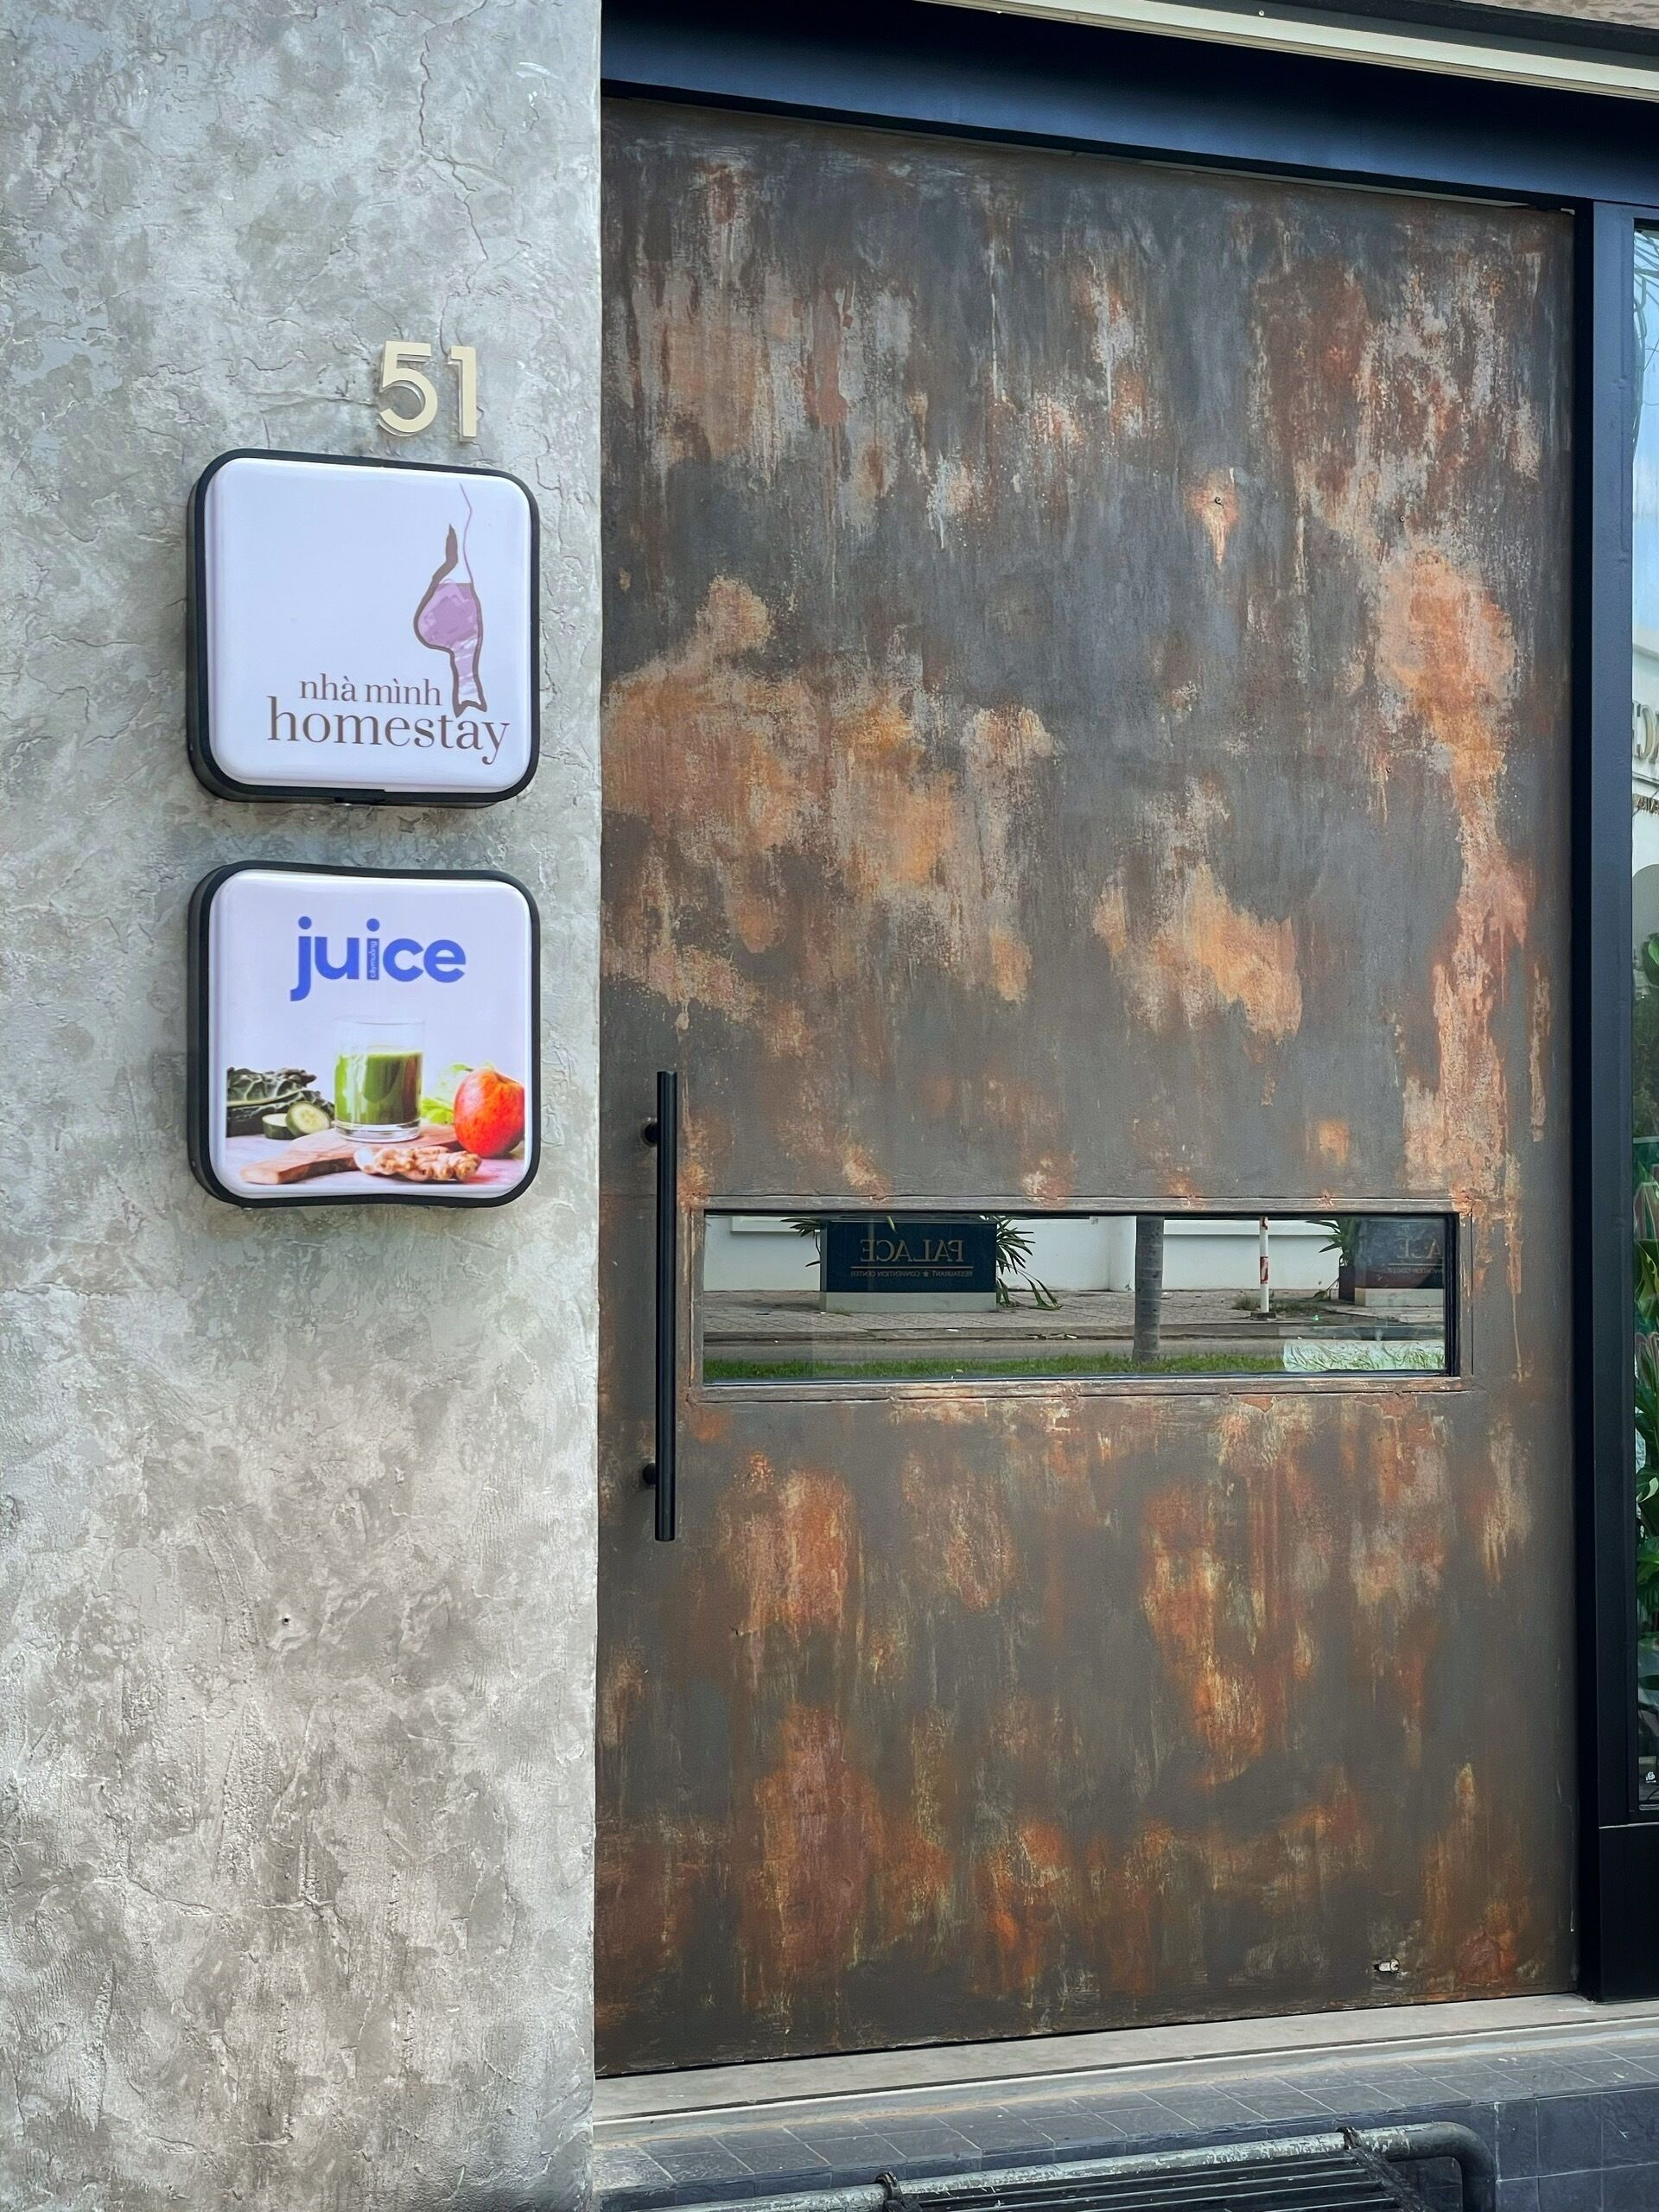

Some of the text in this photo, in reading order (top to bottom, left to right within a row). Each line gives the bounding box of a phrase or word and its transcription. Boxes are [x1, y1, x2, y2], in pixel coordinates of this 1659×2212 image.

[378, 340, 477, 442] 51
[298, 672, 442, 706] nhà mình
[266, 695, 511, 766] homestay
[289, 915, 467, 1002] juice
